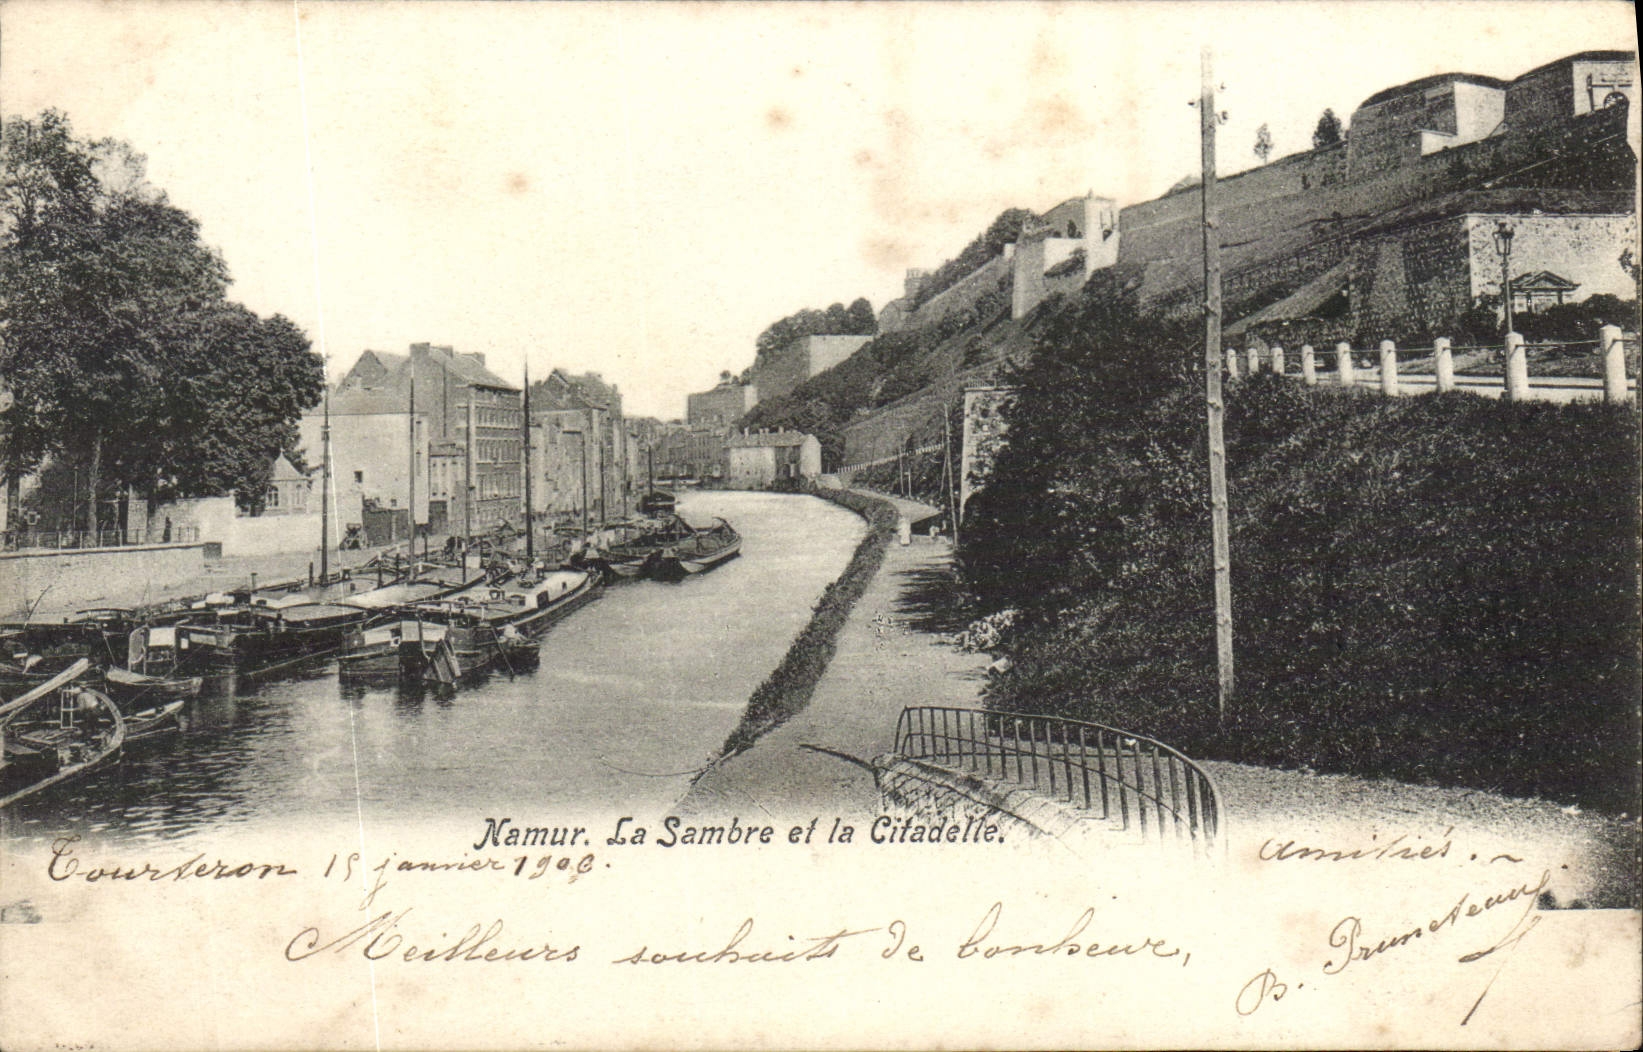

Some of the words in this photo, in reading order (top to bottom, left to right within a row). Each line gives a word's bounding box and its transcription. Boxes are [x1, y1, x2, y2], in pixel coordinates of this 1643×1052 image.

[285, 907, 581, 962] Meilleurs
[612, 917, 882, 963] souhaits
[881, 919, 925, 962] de
[957, 901, 1191, 967] bonheur,
